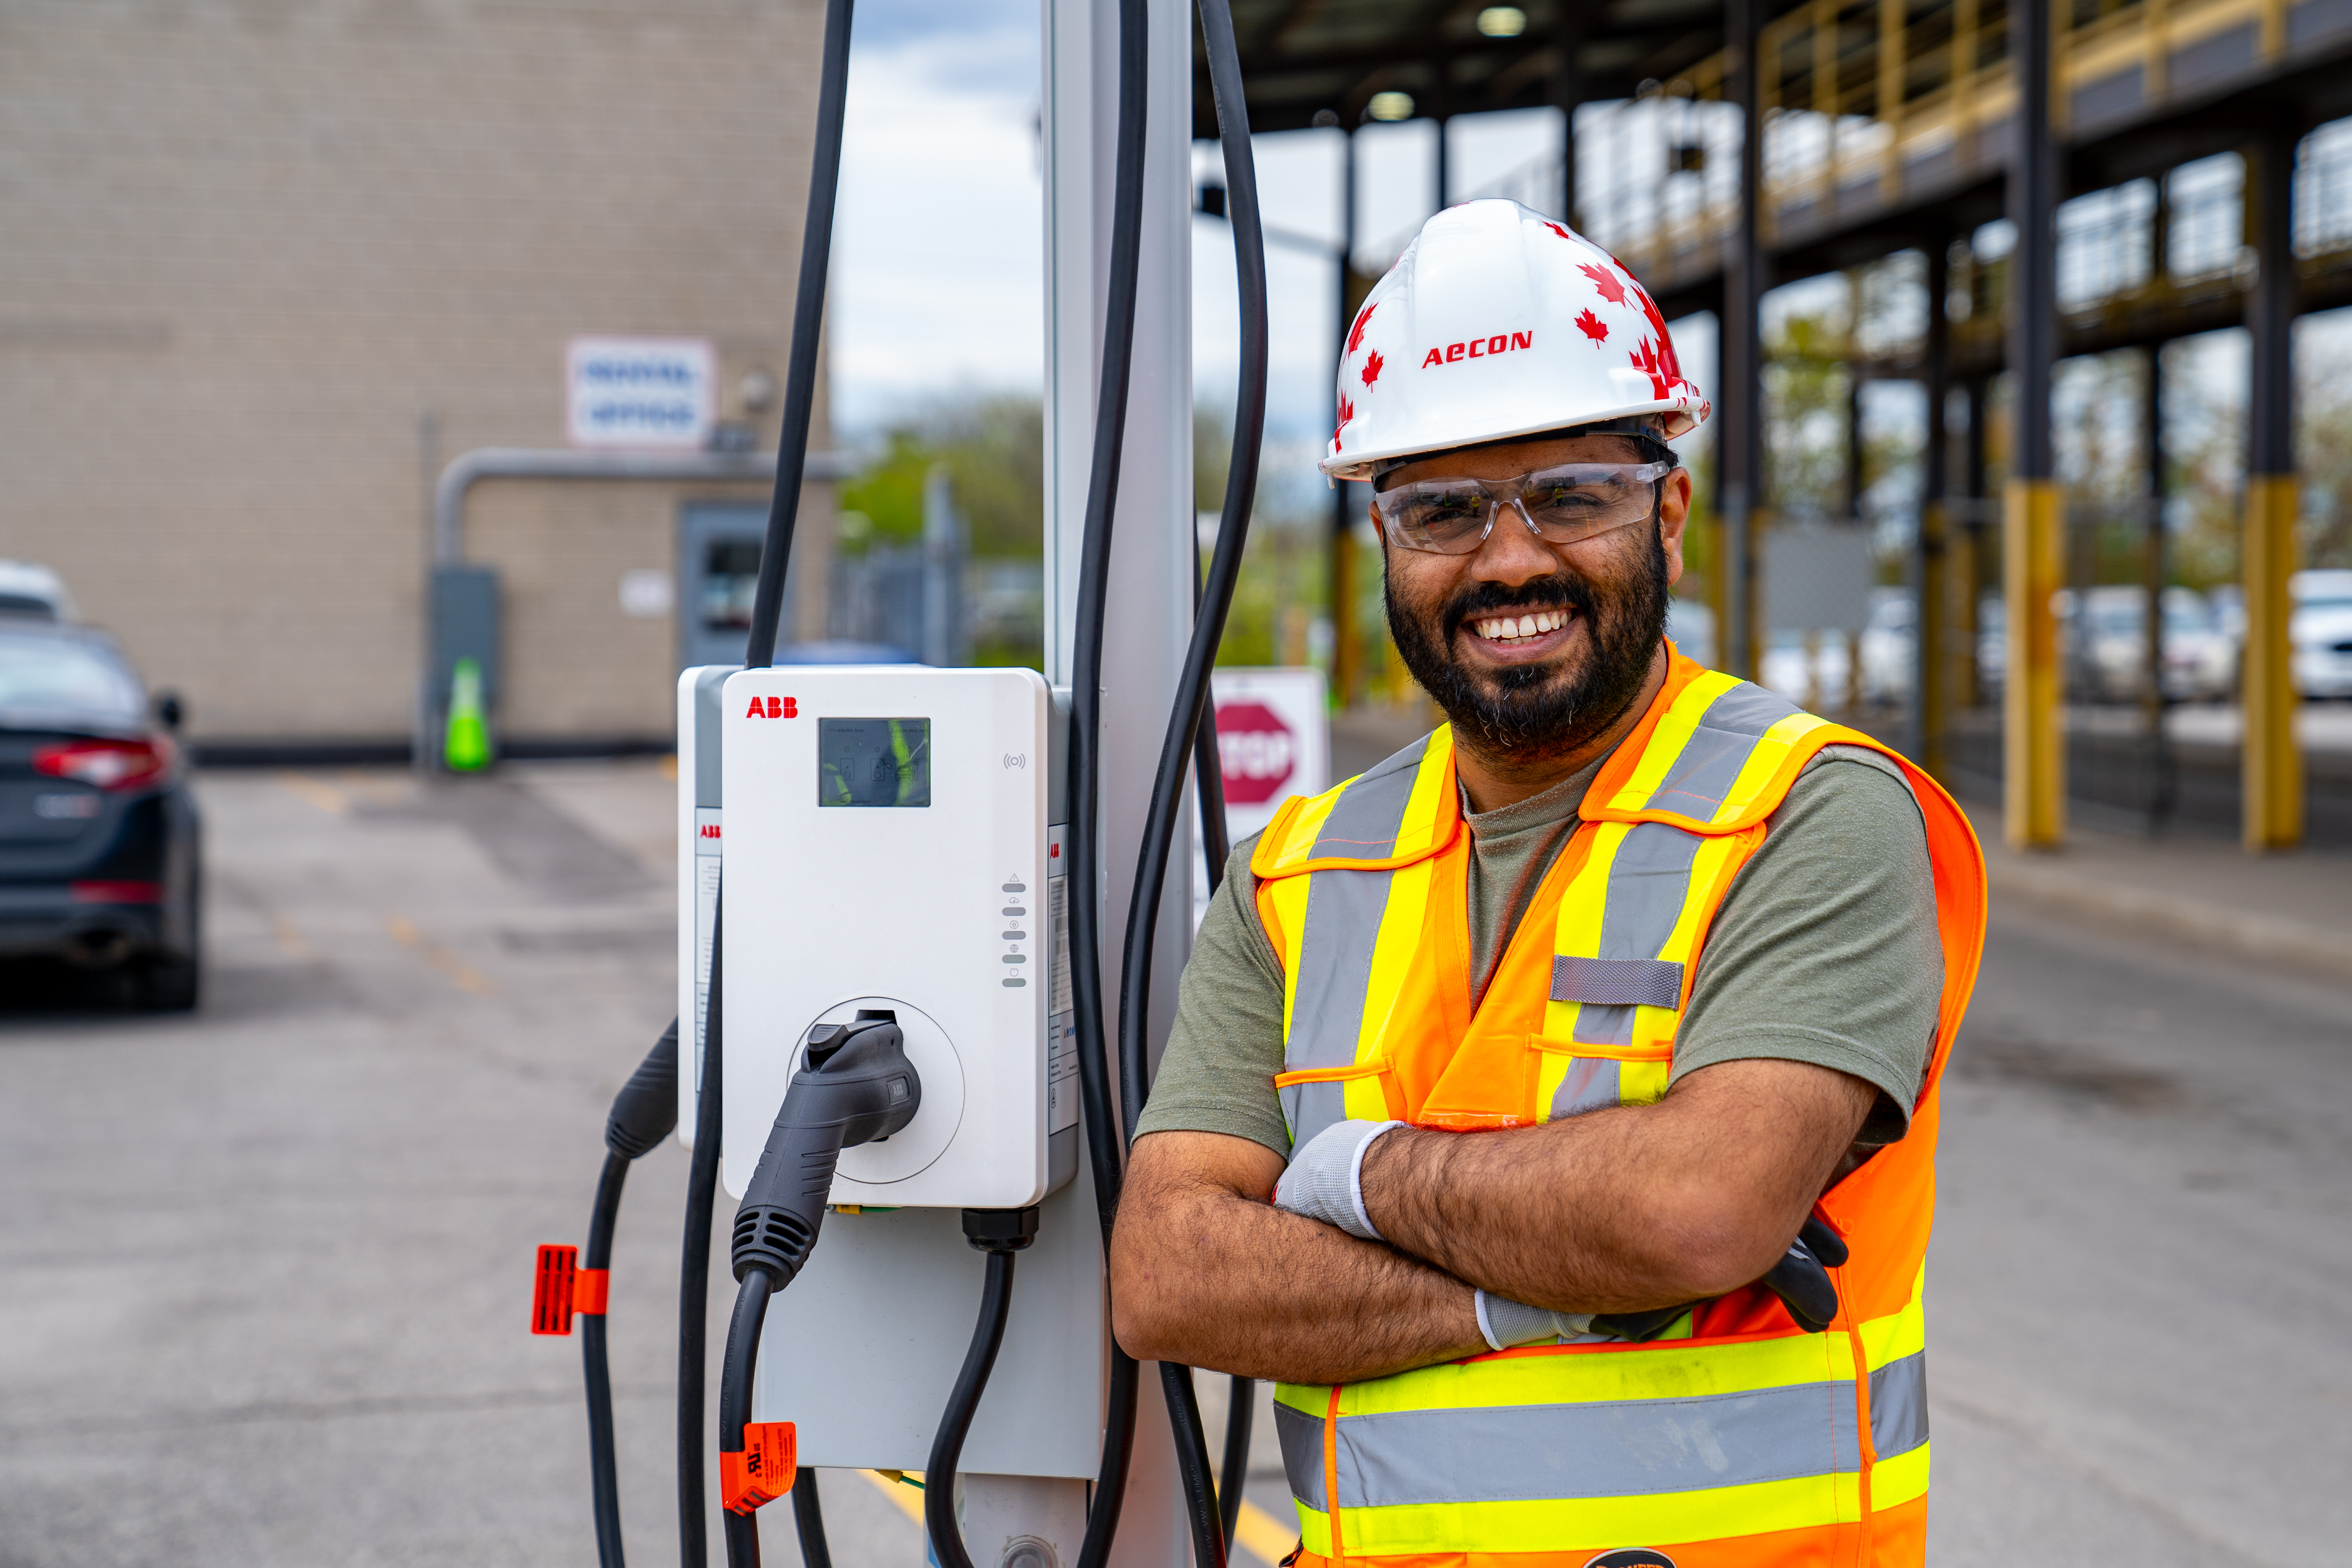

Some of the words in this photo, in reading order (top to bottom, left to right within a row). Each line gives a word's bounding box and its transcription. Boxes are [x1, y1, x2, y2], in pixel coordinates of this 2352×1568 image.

[747, 697, 798, 718] ABB
[1217, 730, 1292, 780] TOP
[700, 825, 721, 838] ABB
[893, 1084, 903, 1097] ABB
